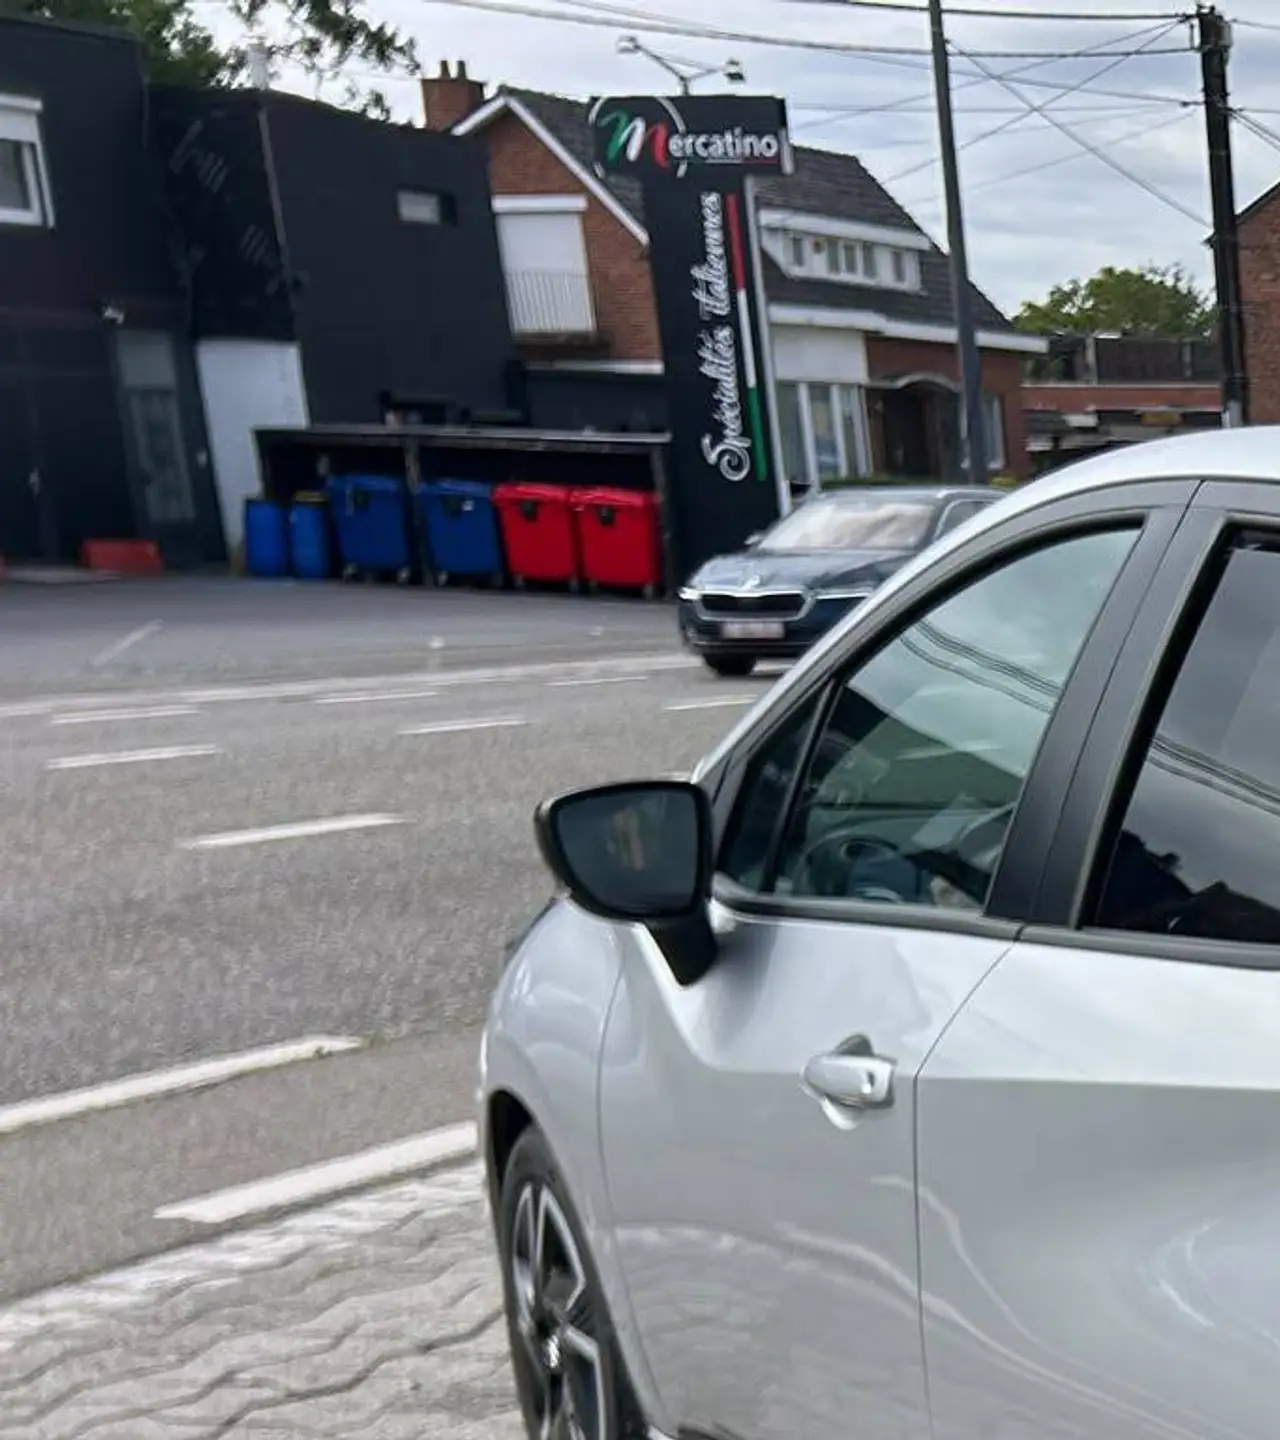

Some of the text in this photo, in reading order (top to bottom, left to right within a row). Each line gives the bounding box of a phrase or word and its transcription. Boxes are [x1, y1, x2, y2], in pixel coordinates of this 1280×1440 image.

[598, 110, 778, 168] Mercatino
[692, 191, 752, 482] Spécialités Italiennes
